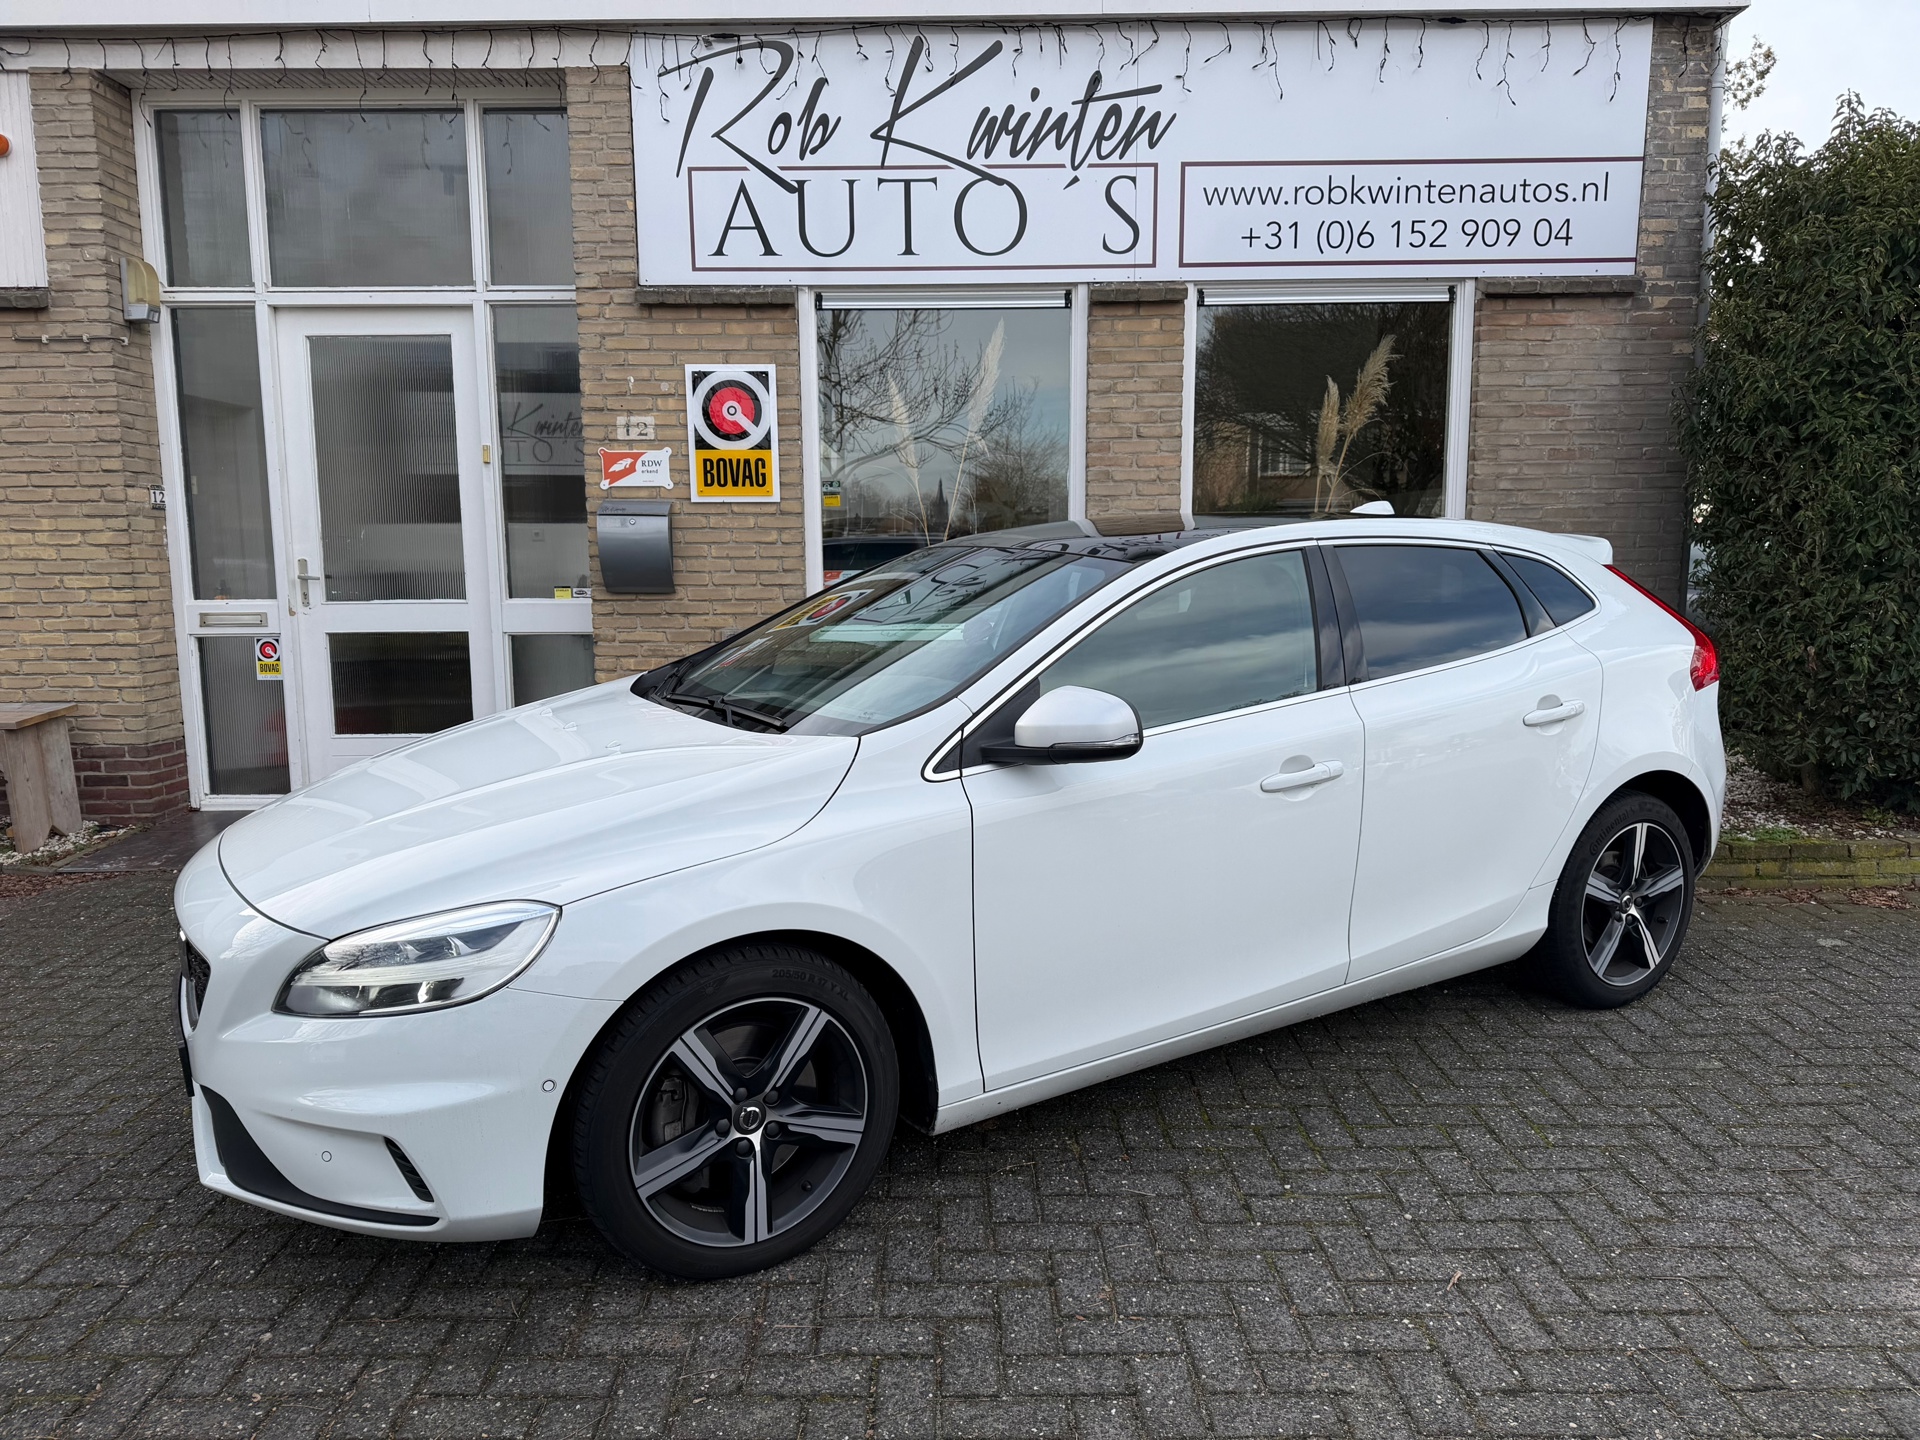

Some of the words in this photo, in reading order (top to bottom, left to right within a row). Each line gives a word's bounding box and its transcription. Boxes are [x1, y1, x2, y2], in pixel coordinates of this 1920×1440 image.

[658, 41, 841, 193] Rob
[870, 36, 1177, 186] Kwinten
[1202, 171, 1609, 206] www.robkwintenautos.nl
[1240, 220, 1300, 250] +31
[1316, 219, 1375, 254] (0)6
[1391, 219, 1448, 249] 152
[1461, 218, 1521, 248] 909
[1533, 218, 1574, 247] 04
[507, 402, 583, 442] Kwinte
[624, 421, 648, 436] 12
[641, 460, 663, 468] RDW
[703, 457, 767, 488] BOVAG
[152, 491, 166, 503] 12
[259, 663, 280, 673] BOVAG
[1590, 809, 1630, 856] Continental
